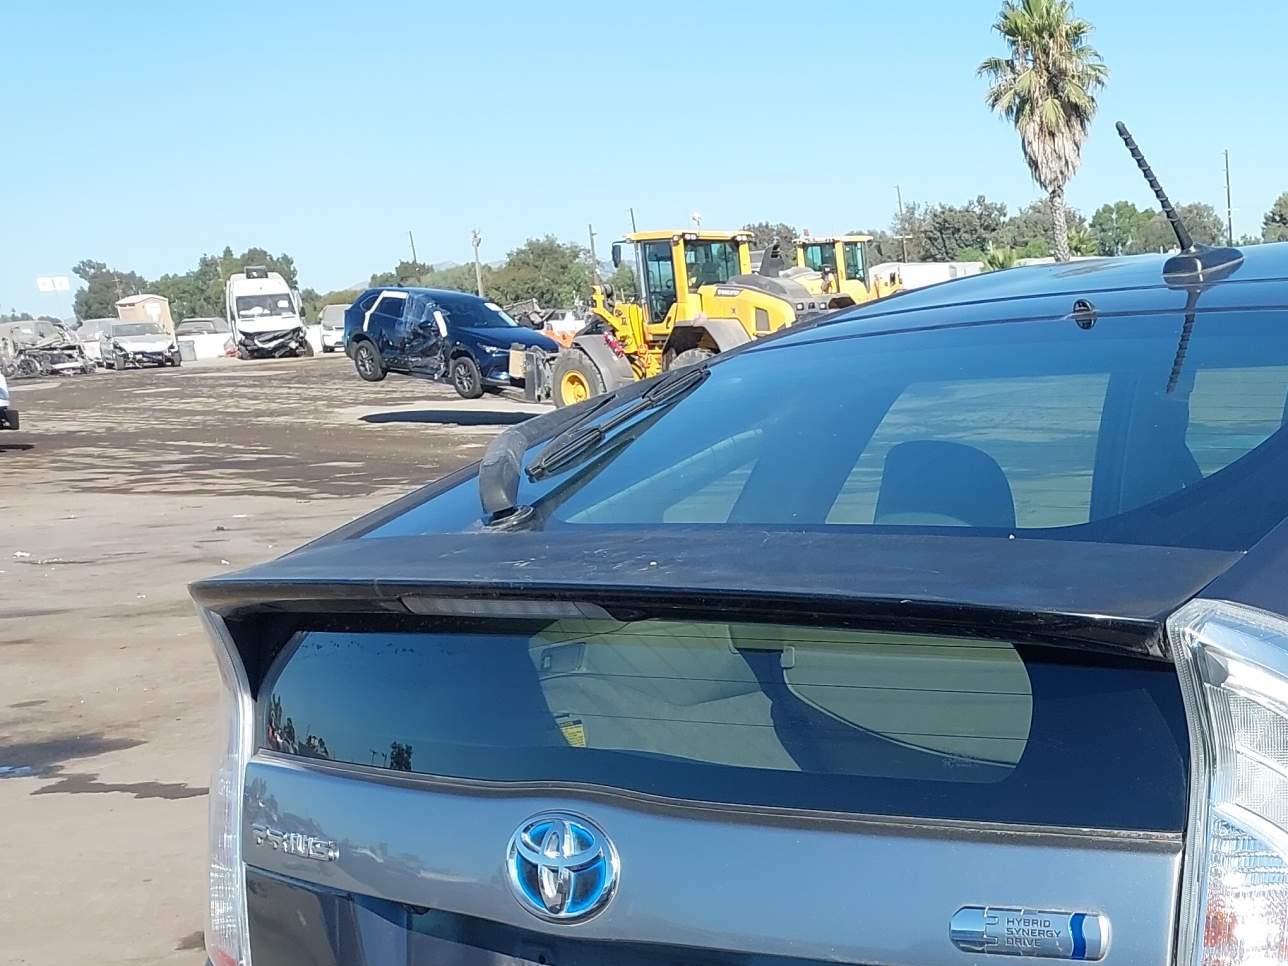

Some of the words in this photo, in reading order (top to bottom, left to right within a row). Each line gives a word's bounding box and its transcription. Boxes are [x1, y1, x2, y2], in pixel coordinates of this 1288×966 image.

[1006, 917, 1051, 928] HYBRID
[1006, 927, 1061, 938] SYNERGY
[1006, 937, 1041, 947] DRIVE
